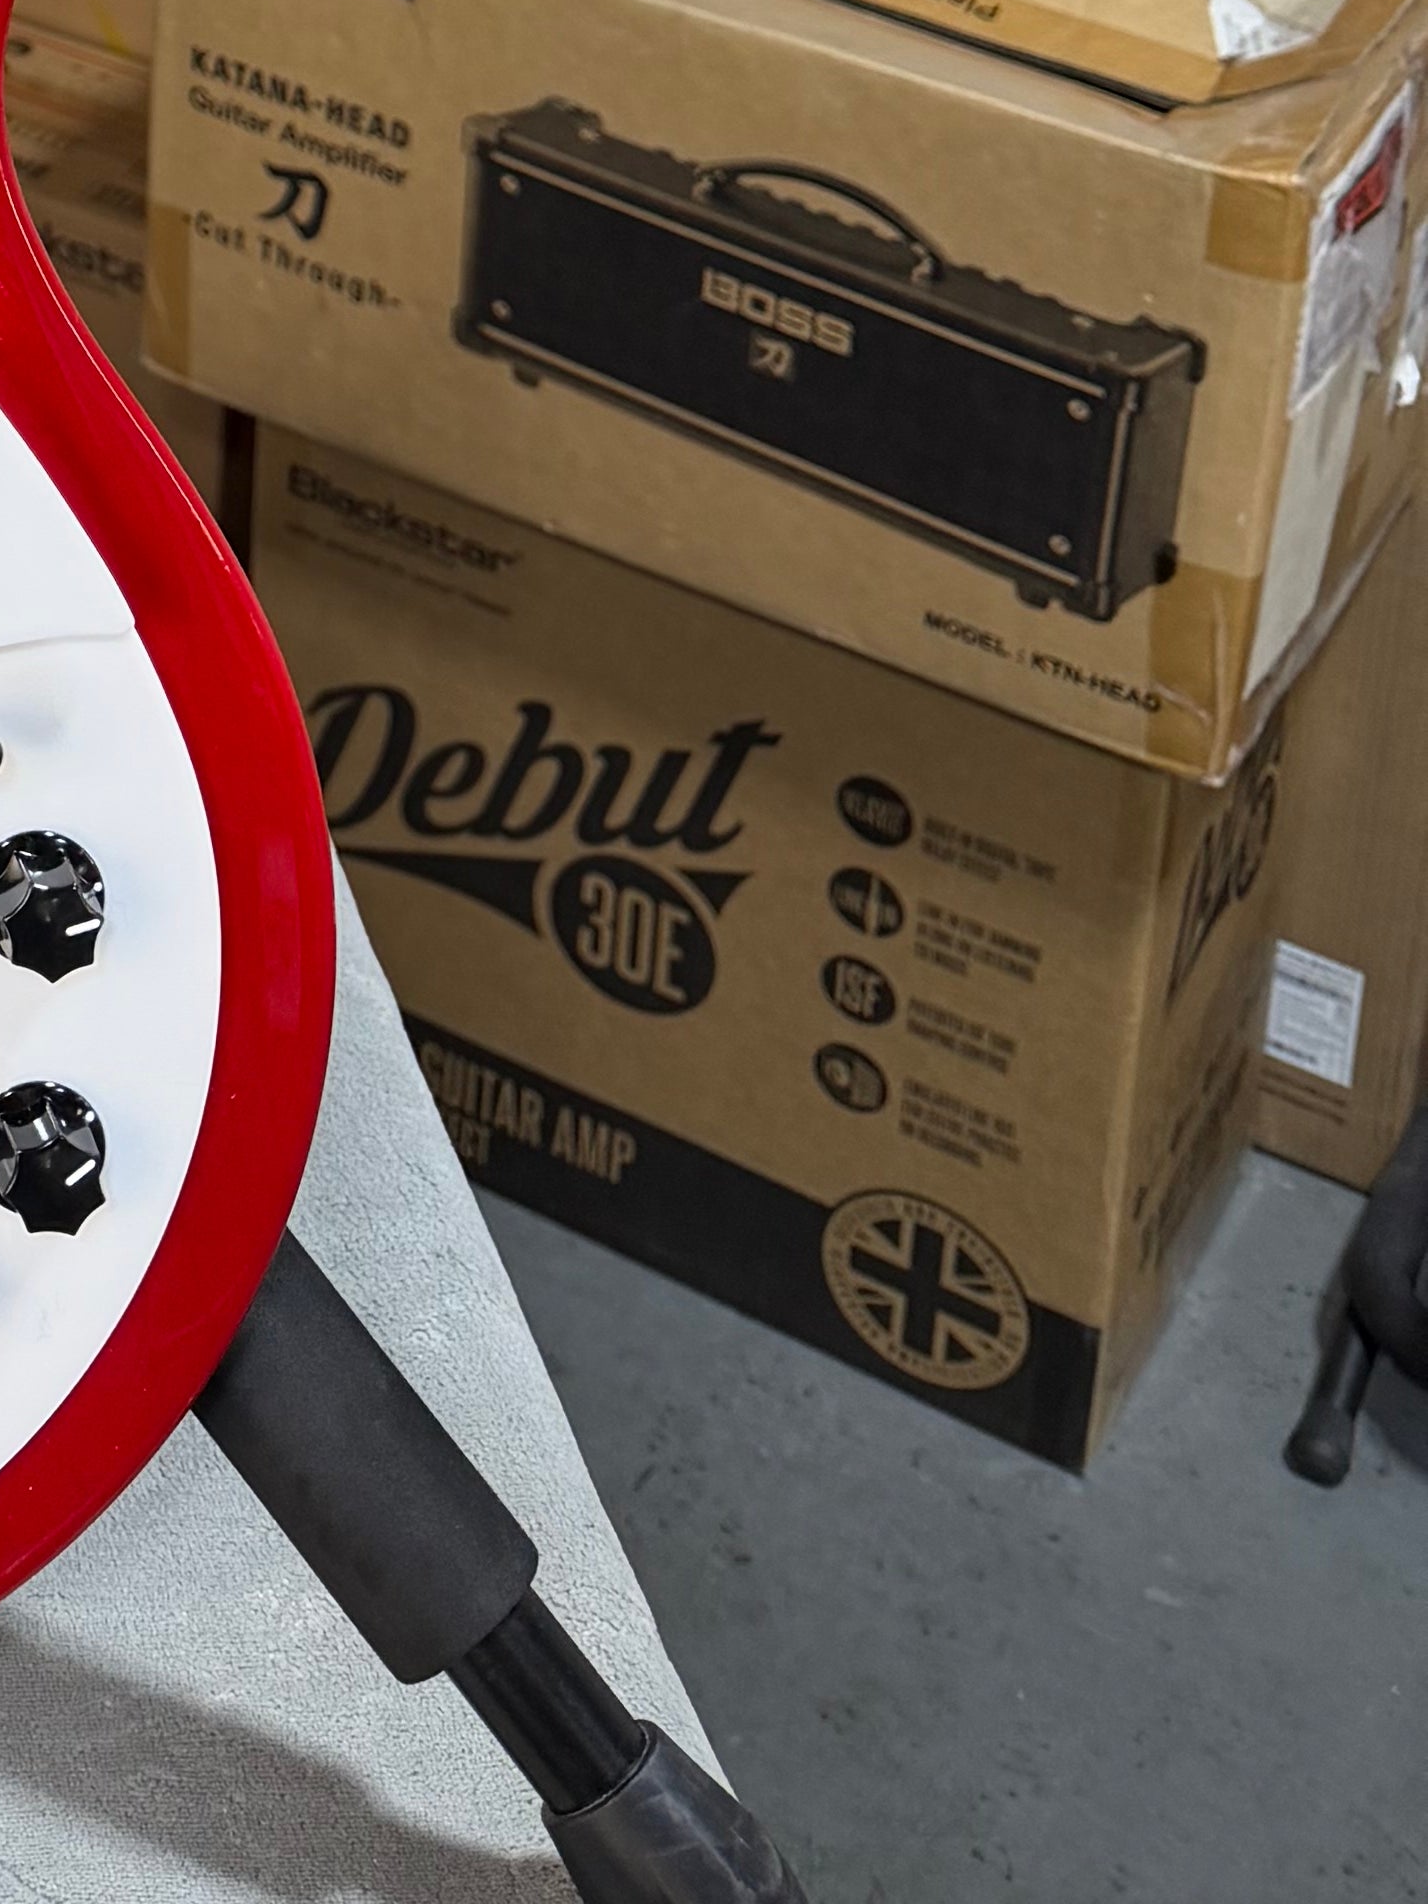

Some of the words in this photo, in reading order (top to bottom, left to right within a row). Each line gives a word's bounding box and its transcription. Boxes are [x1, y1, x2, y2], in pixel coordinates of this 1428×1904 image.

[188, 85, 271, 135] Guitar
[279, 121, 409, 189] Amplifier
[189, 44, 412, 149] KATANA-HEAD
[700, 266, 855, 358] BOSS
[923, 609, 1012, 660] MODEL
[308, 684, 784, 855] Debut
[577, 884, 690, 1006] 30E
[420, 1041, 545, 1149] GUITAR
[549, 1105, 637, 1185] AMP
